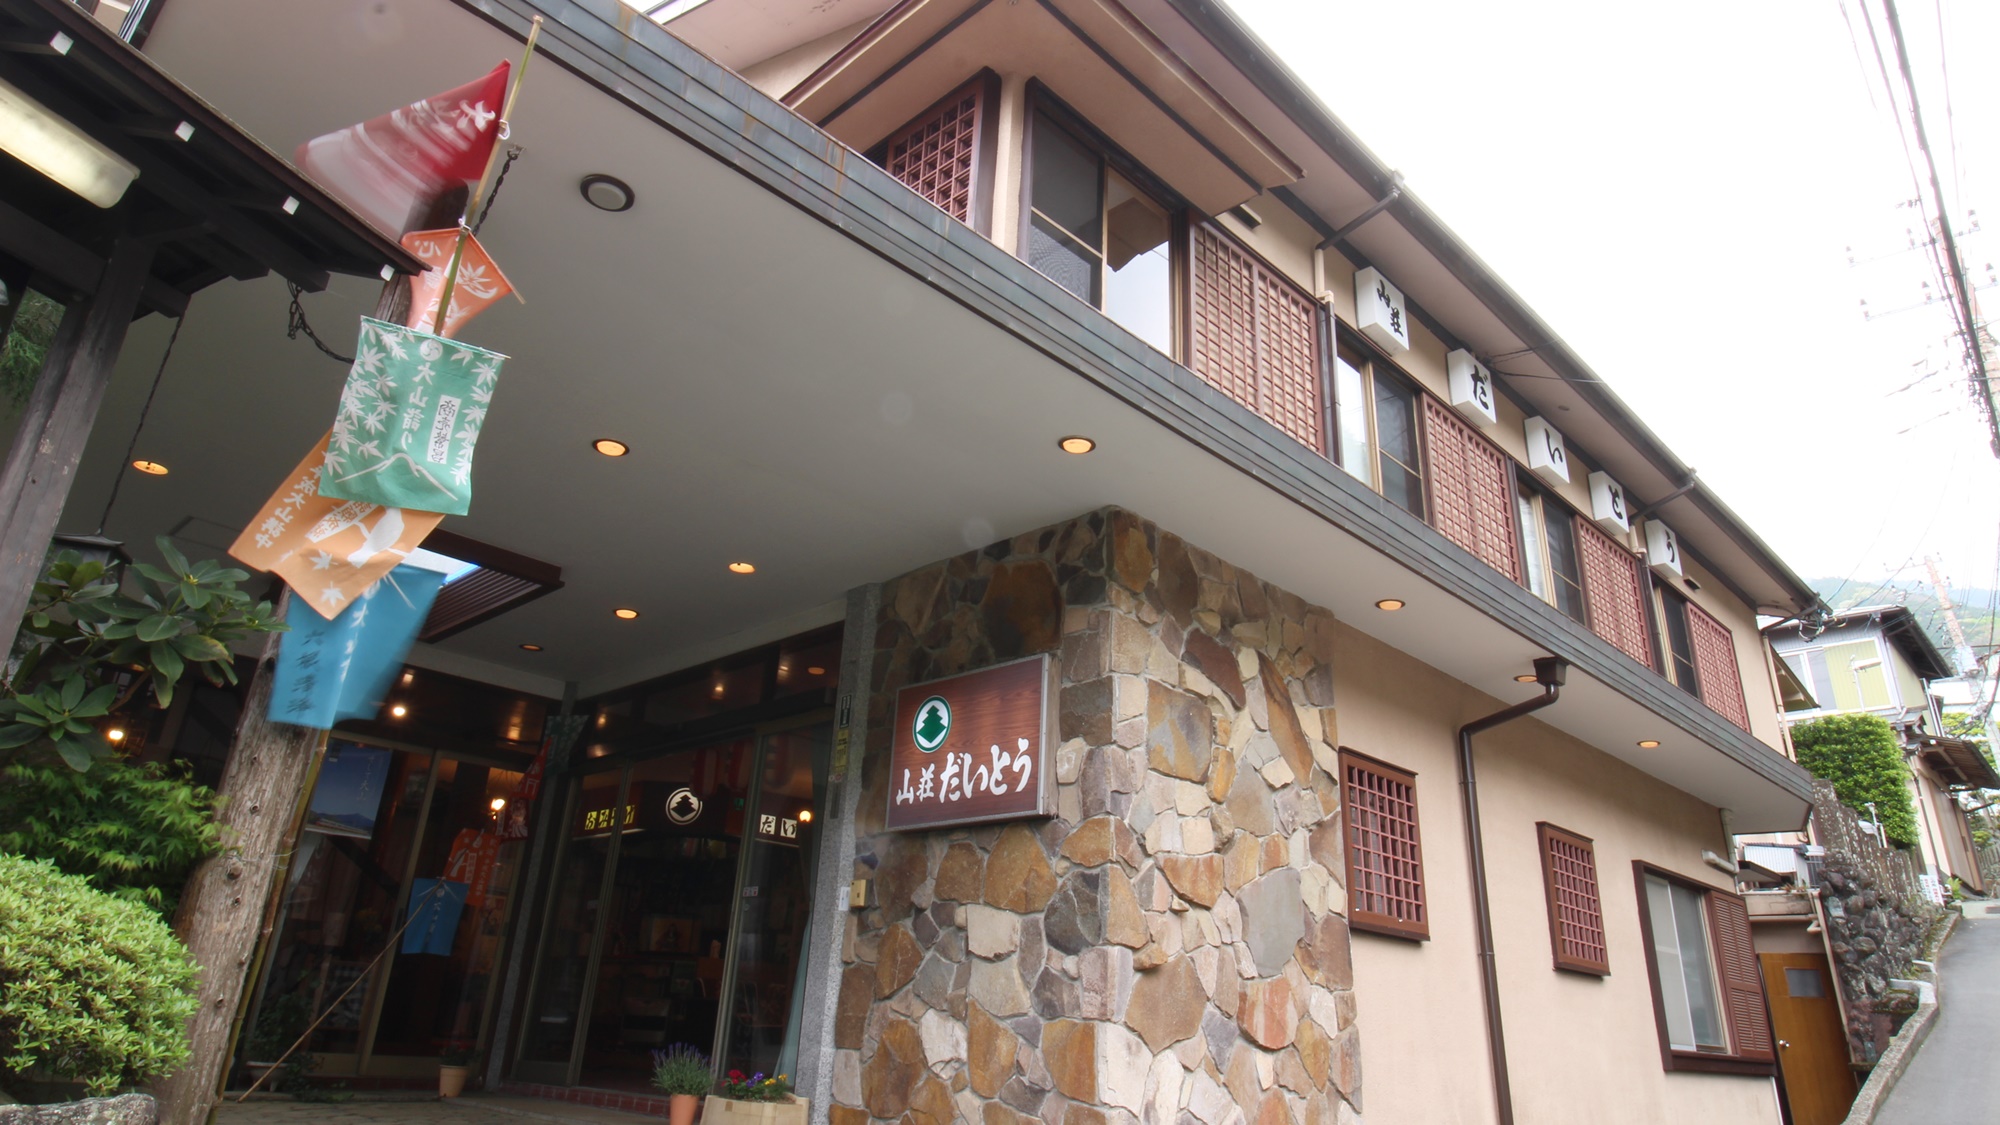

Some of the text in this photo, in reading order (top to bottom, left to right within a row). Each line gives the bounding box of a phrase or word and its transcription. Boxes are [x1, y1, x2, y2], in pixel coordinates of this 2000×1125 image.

[896, 737, 1033, 806] 山荘だいとう
